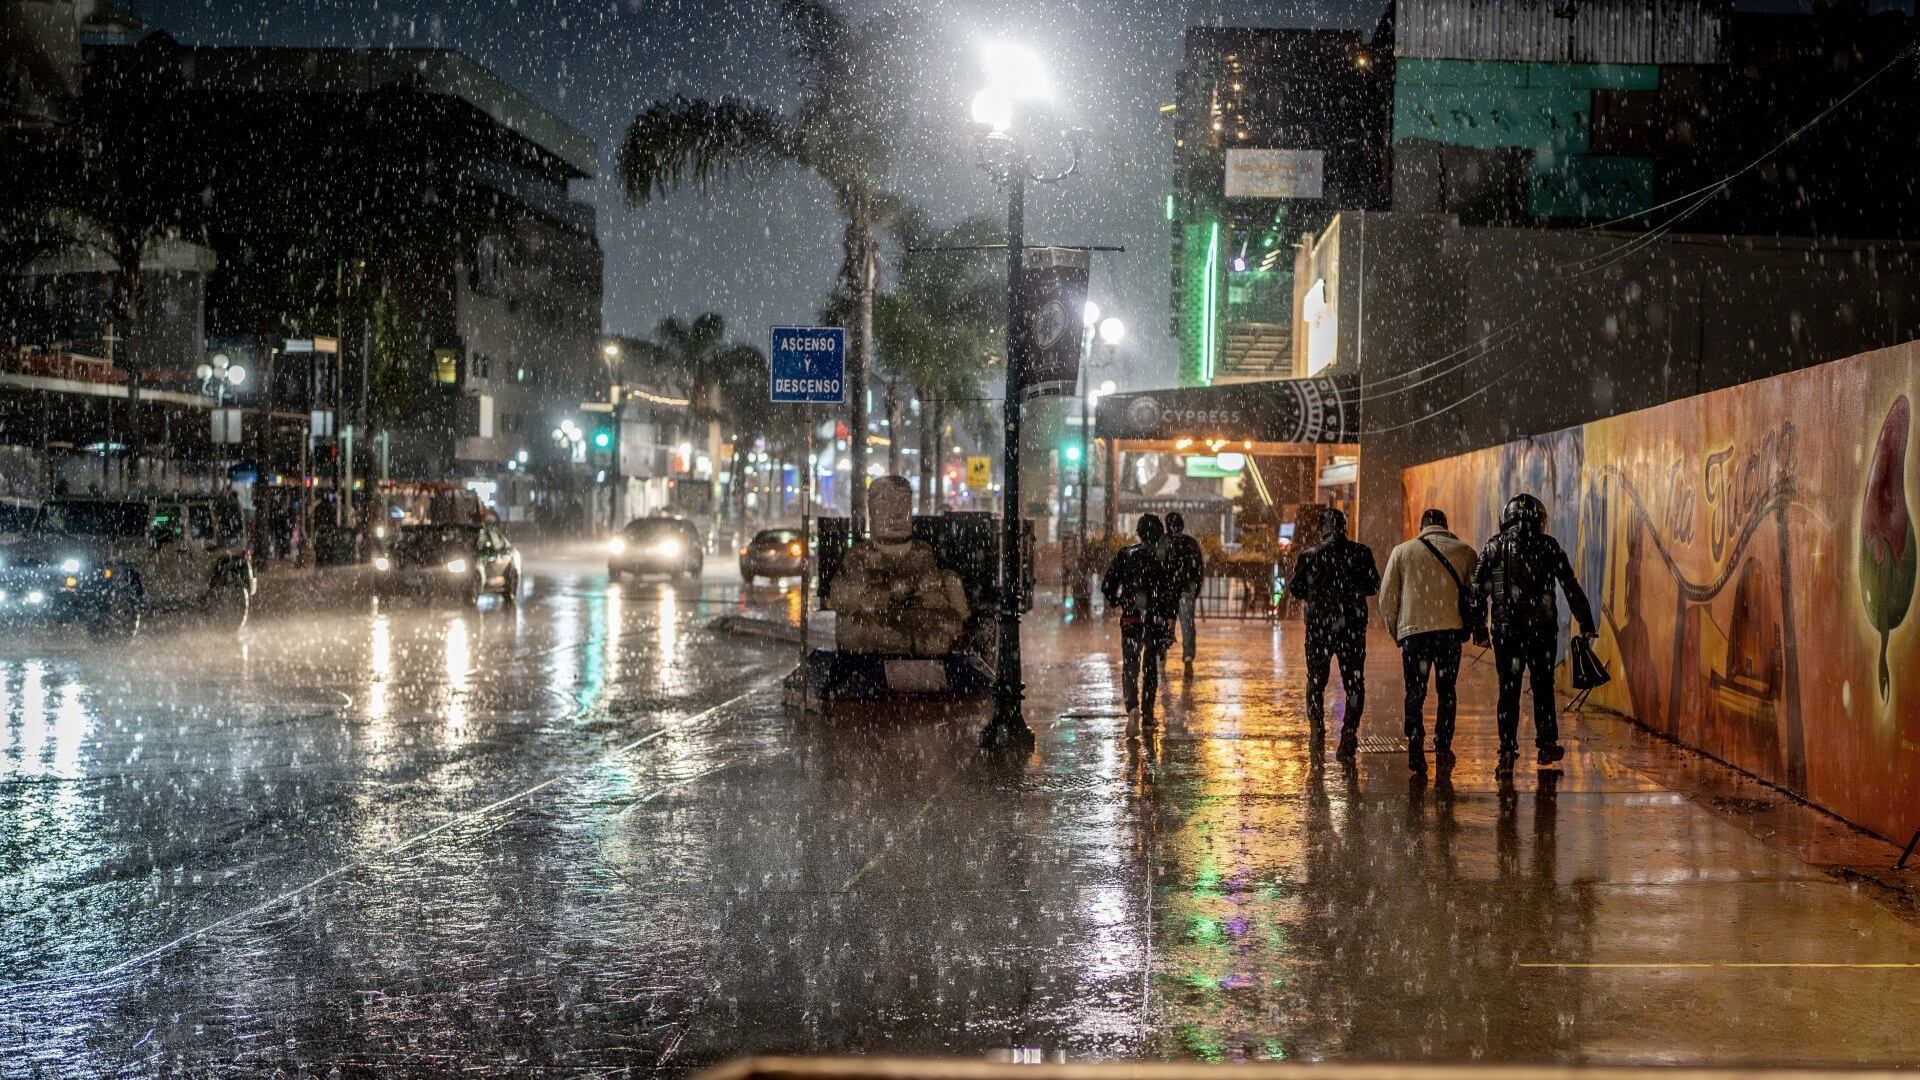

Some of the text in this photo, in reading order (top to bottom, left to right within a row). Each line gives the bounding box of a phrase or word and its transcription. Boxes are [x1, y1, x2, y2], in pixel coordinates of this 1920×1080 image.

[781, 338, 835, 351] ASCENSO
[804, 357, 811, 374] Y
[775, 379, 840, 393] DESCENSO
[1162, 409, 1240, 424] CYPRESS
